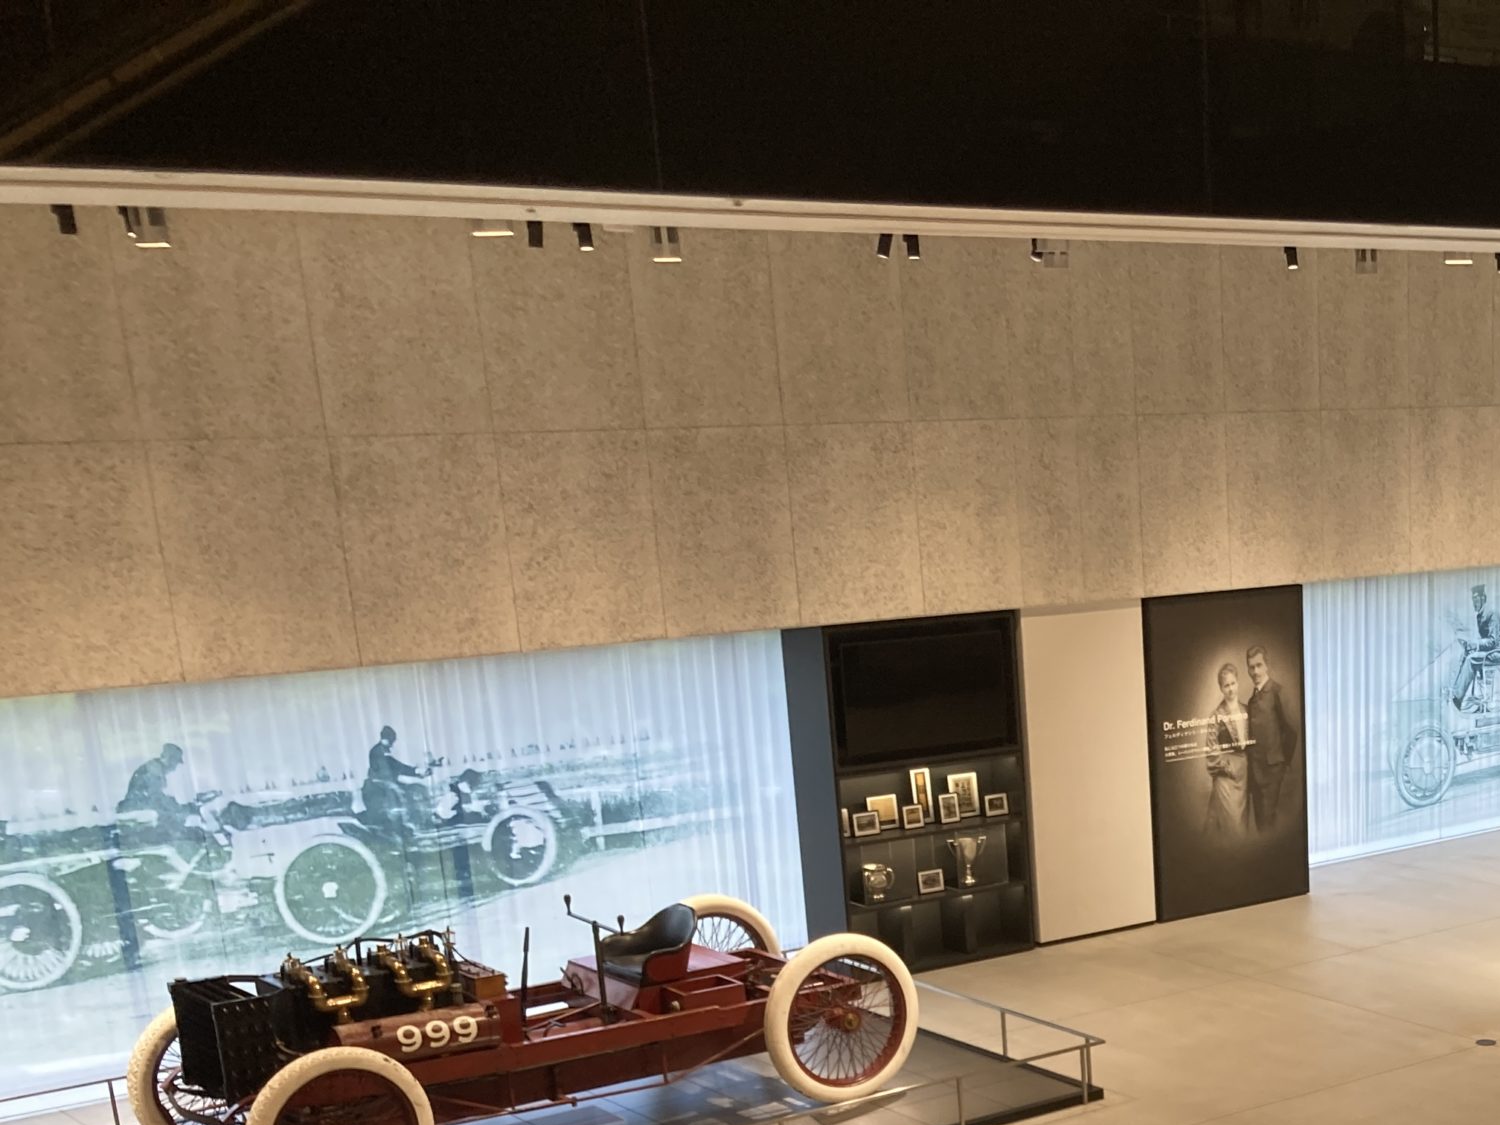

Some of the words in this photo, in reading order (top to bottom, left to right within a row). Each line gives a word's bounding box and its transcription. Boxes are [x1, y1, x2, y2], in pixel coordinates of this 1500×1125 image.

[1163, 722, 1175, 731] Dr.
[1176, 714, 1216, 729] Ferdinand
[396, 1015, 478, 1053] 999
